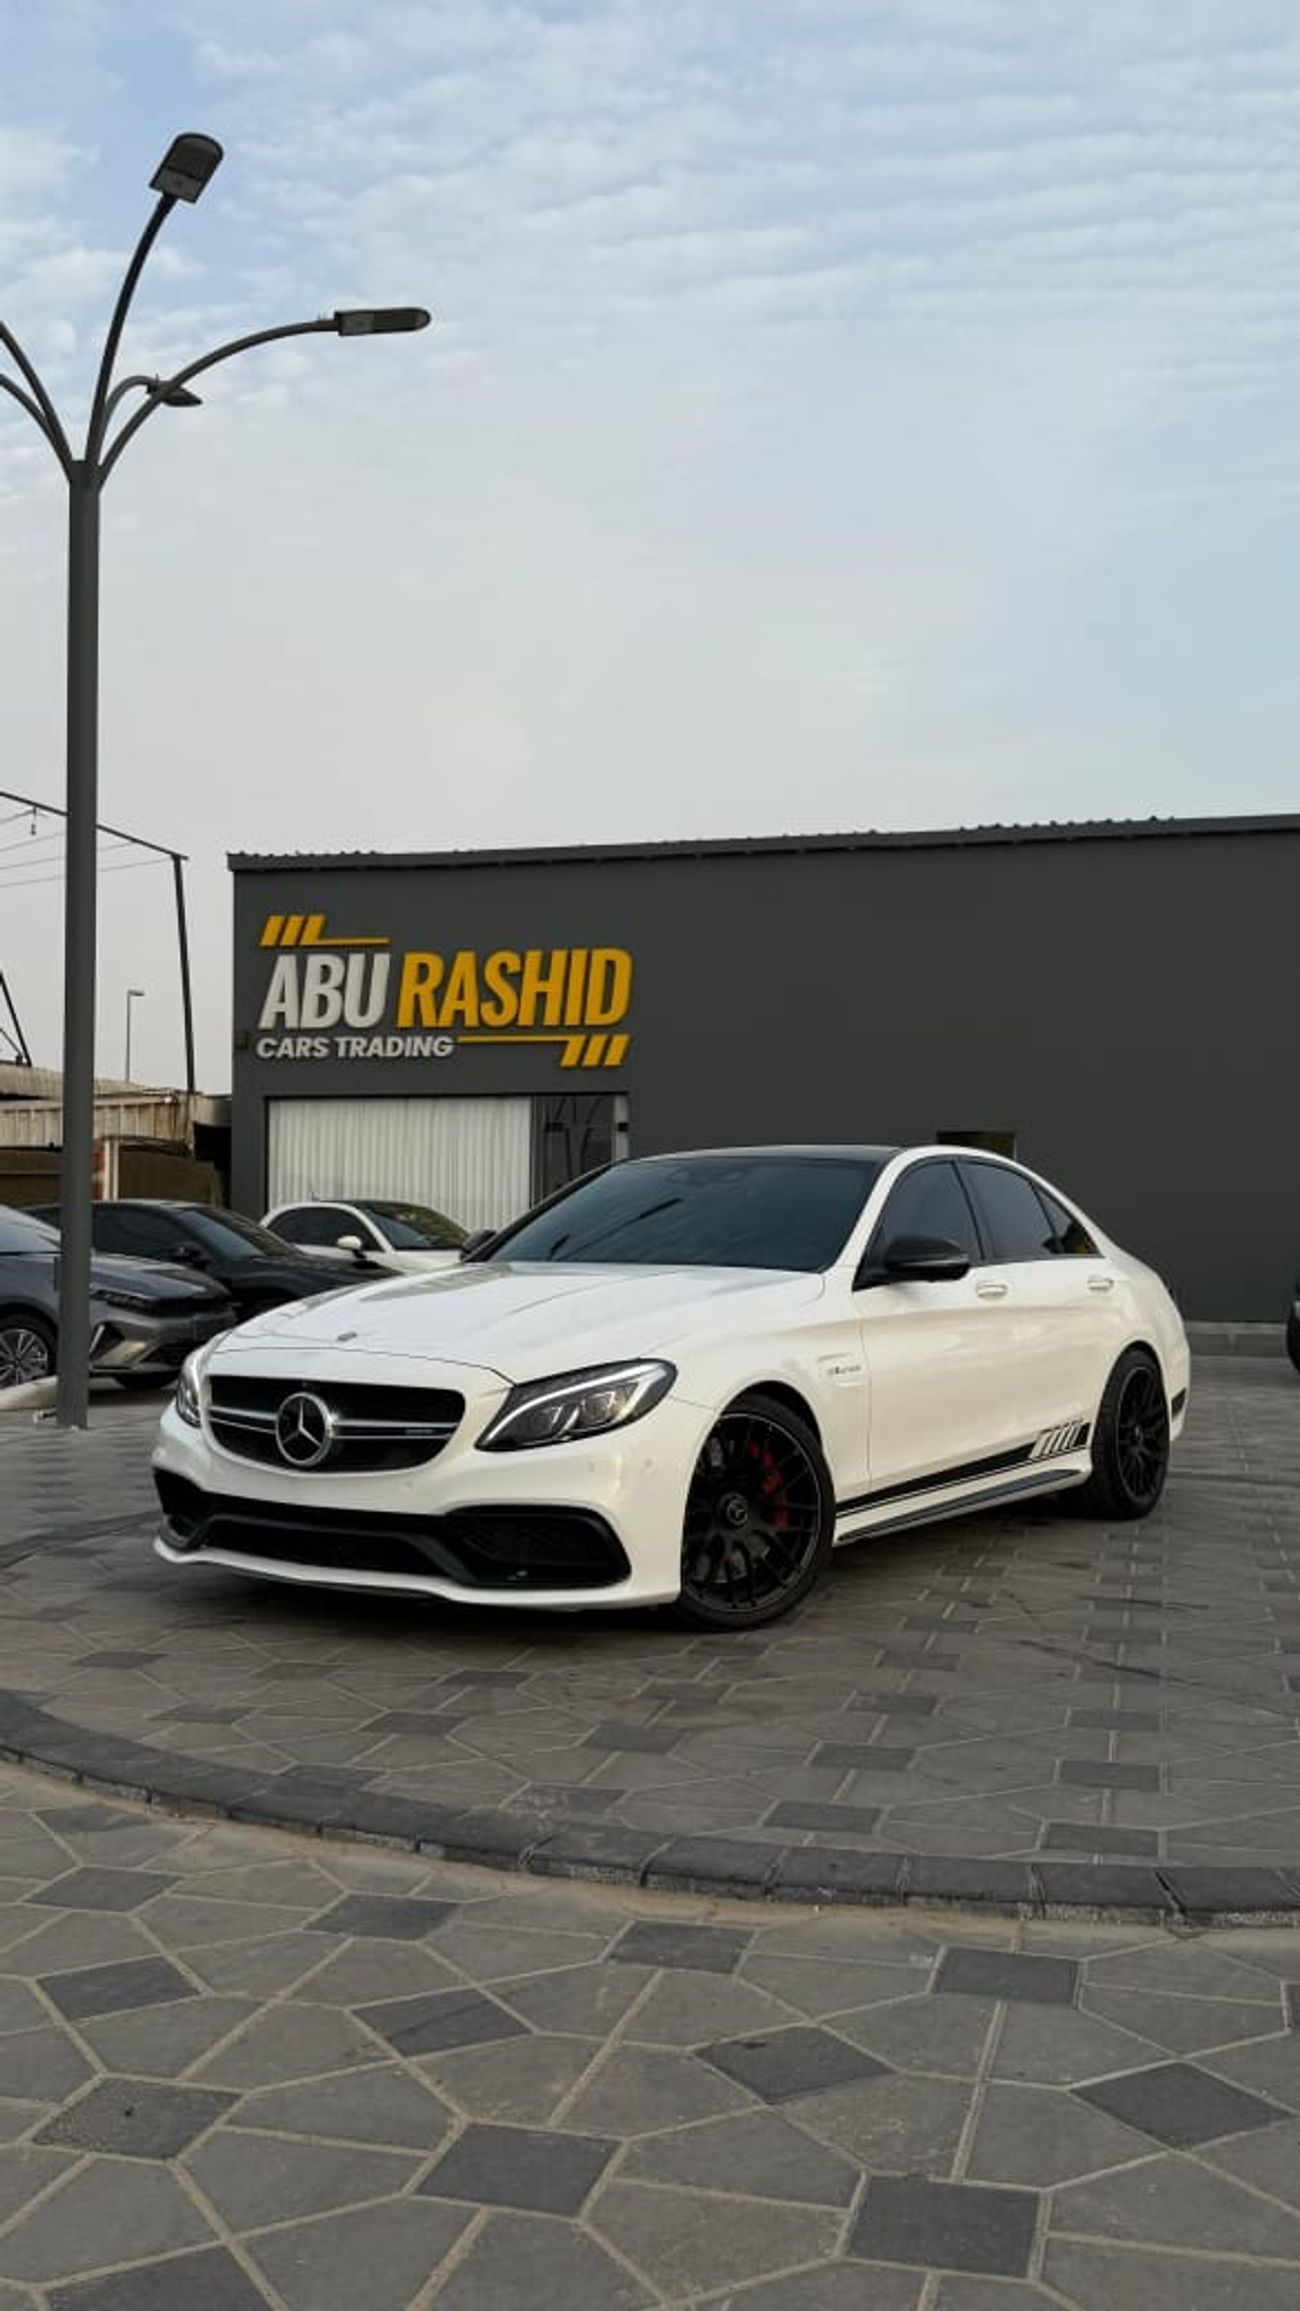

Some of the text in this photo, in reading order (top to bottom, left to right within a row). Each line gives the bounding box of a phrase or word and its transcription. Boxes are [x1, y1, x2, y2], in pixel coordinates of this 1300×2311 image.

[258, 947, 633, 1029] ABU RASHID
[256, 1035, 455, 1058] CARS TRADING
